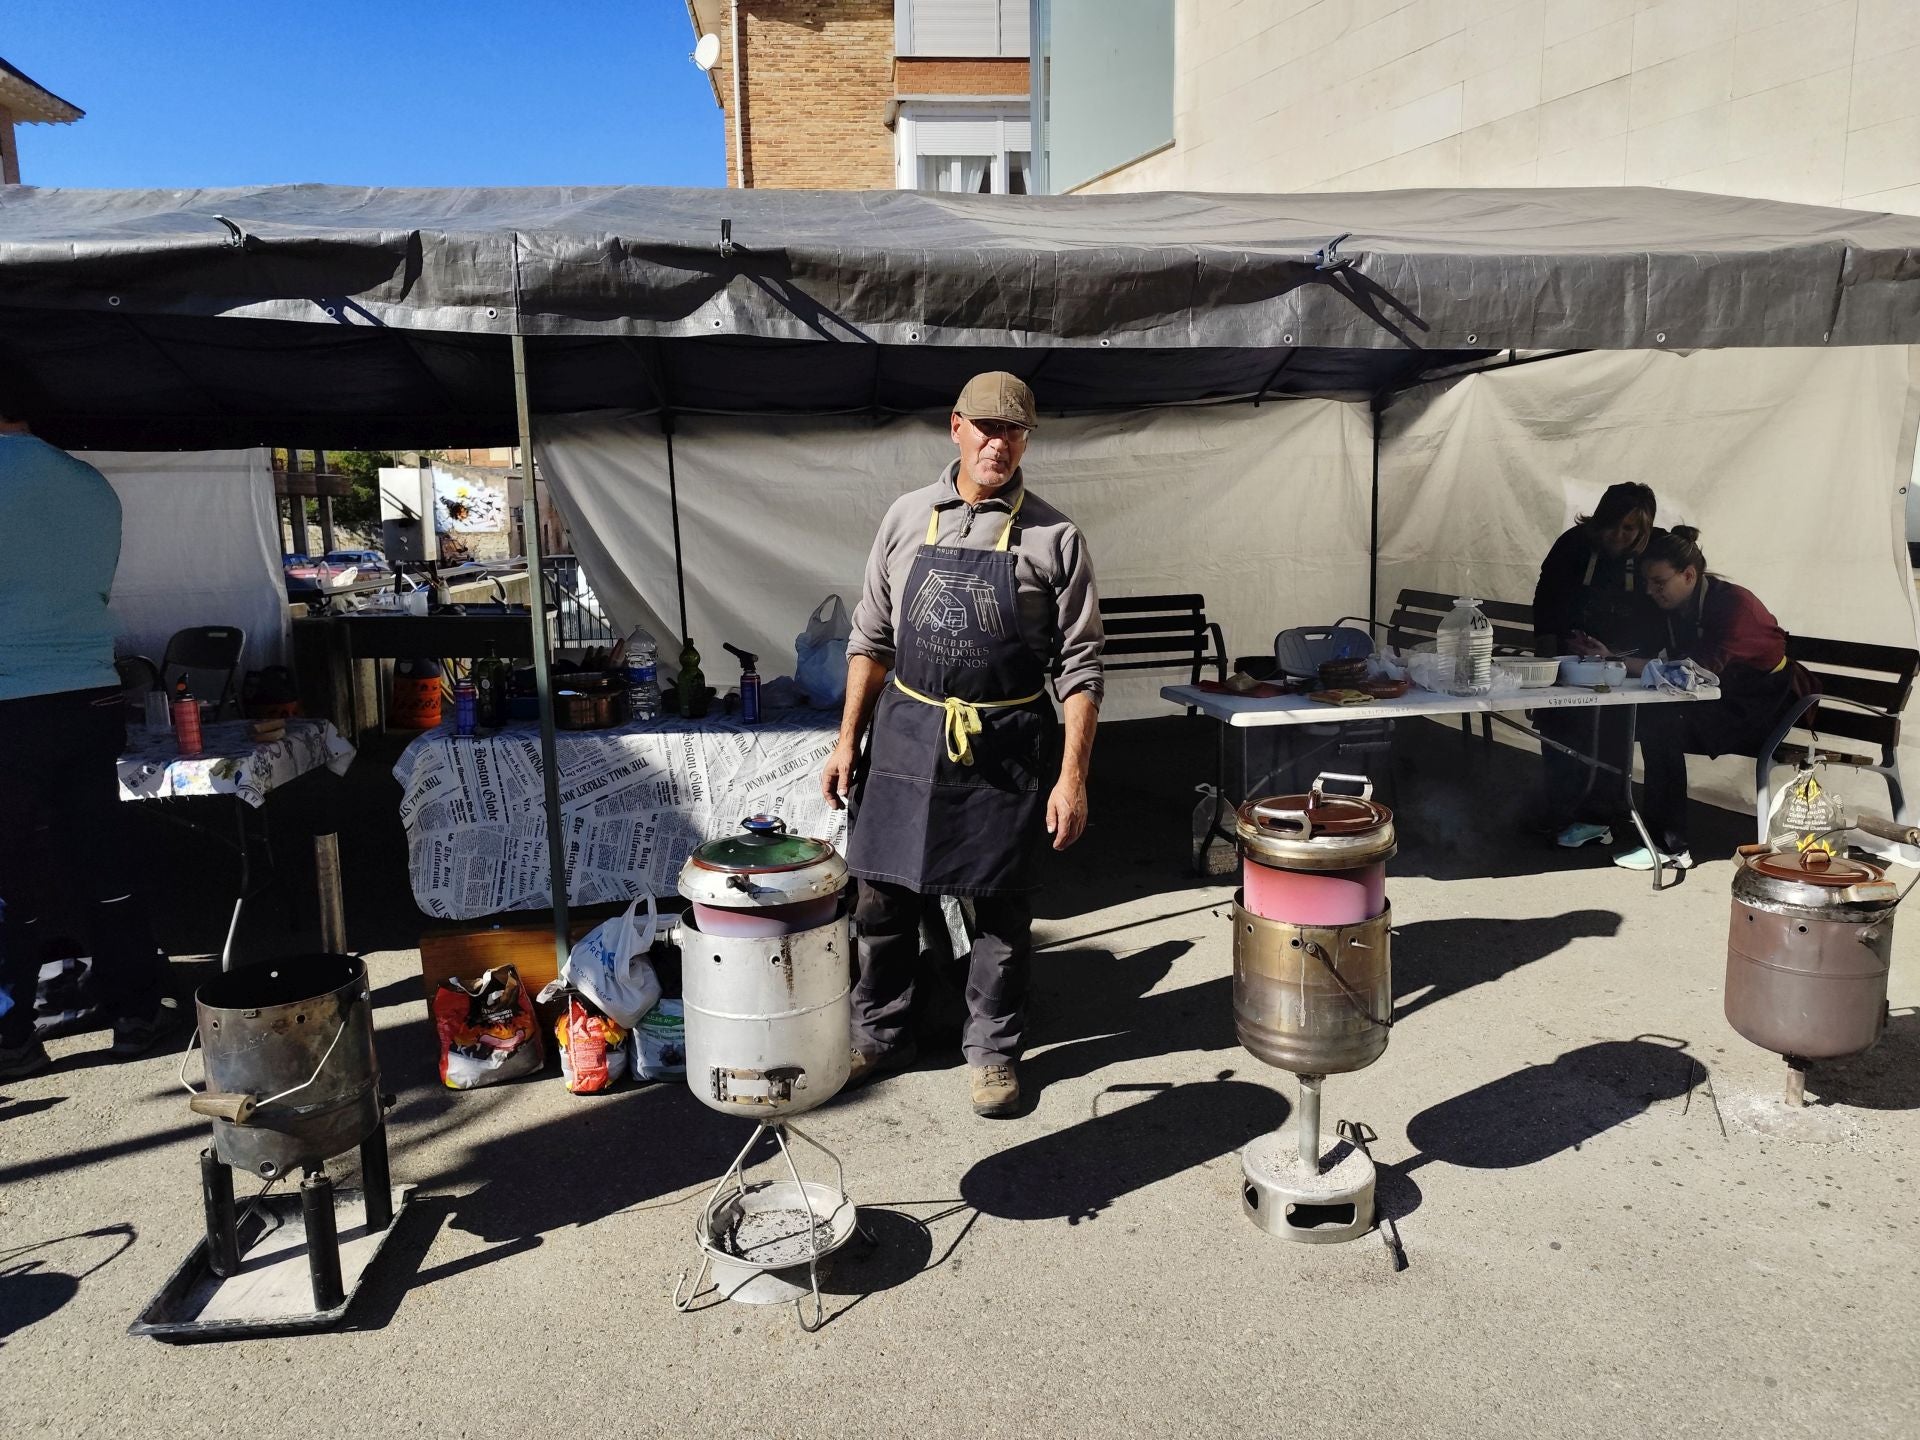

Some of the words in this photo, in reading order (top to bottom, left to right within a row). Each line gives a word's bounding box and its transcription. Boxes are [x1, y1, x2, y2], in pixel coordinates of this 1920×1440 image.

[915, 636, 990, 657] ENTIRADORES
[931, 635, 957, 647] CLUB
[960, 640, 974, 648] DE
[630, 757, 650, 770] THE
[779, 756, 809, 776] STREET
[474, 748, 490, 787] Boston
[482, 789, 499, 822] Globe
[609, 766, 632, 783] WALL
[743, 769, 778, 793] JOURNAL
[577, 774, 610, 799] STREET
[574, 816, 584, 835] The
[645, 826, 655, 843] The
[532, 841, 543, 863] State
[627, 821, 643, 871] Californian
[432, 840, 443, 889] Californian
[640, 847, 651, 870] Daily
[441, 866, 451, 888] Daily
[427, 898, 446, 916] ALL
